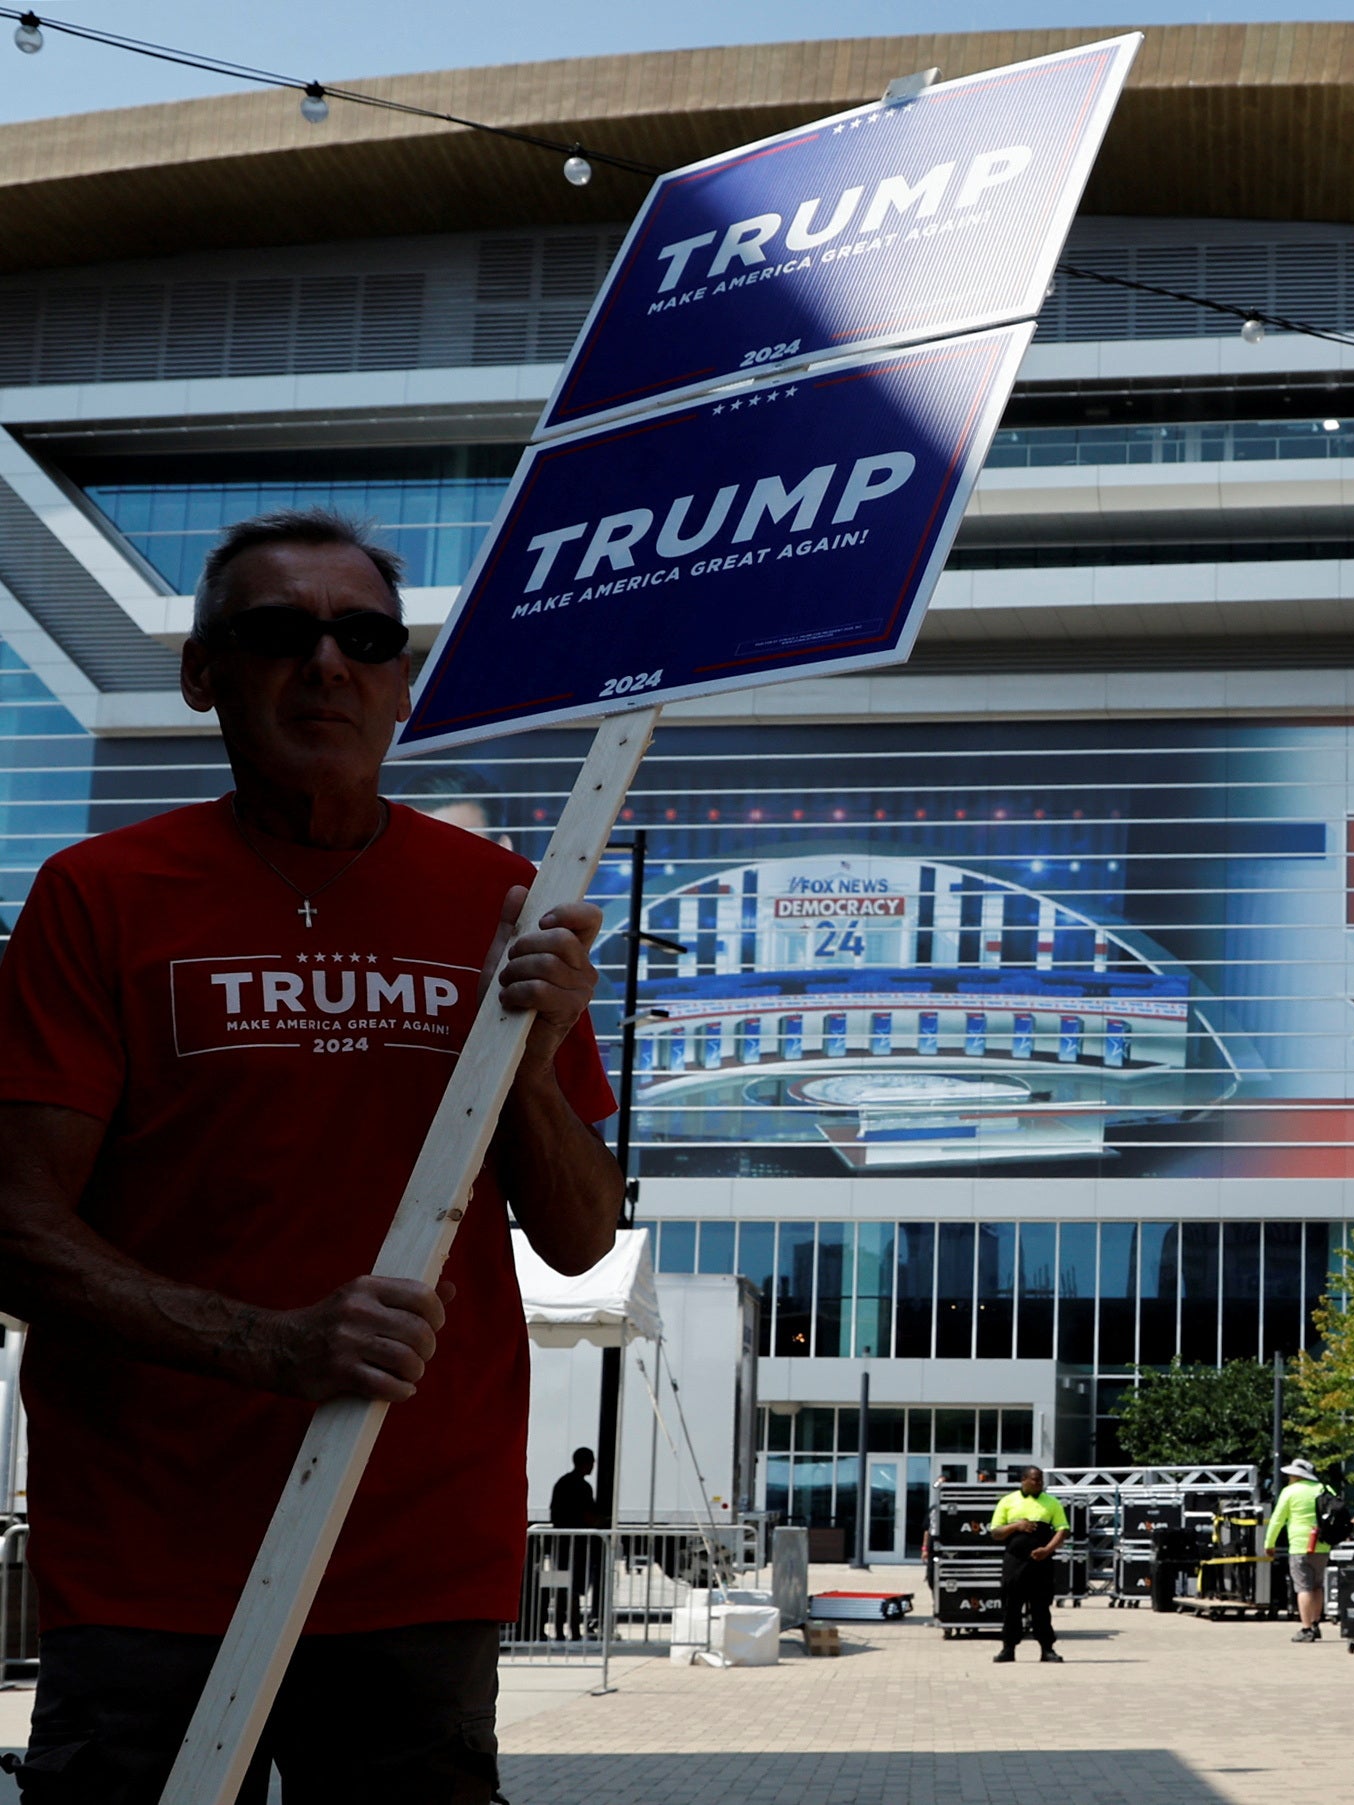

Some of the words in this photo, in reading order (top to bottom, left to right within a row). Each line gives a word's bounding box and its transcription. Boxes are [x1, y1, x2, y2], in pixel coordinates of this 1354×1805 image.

[657, 144, 1033, 293] TRUMP
[647, 287, 705, 315] MAKE
[713, 257, 811, 295] AMERICA
[821, 233, 898, 263] GREAT
[904, 210, 991, 242] AGAIN!
[739, 339, 801, 367] 2024
[523, 451, 916, 593] TRUMP
[511, 592, 574, 619] MAKE
[578, 567, 680, 604] AMERICA
[690, 548, 770, 576] GREAT
[777, 529, 869, 560] AGAIN!
[599, 669, 663, 697] 2024
[801, 879, 834, 893] FOX
[839, 879, 888, 893] NEWS
[779, 900, 900, 916] DEMOCRACY
[815, 920, 864, 957] 24
[211, 970, 459, 1016] TRUMP
[227, 1019, 270, 1031] MAKE
[276, 1019, 341, 1030] AMERICA
[348, 1019, 397, 1029] GREAT
[403, 1020, 449, 1035] AGAIN!
[313, 1037, 369, 1053] 2024
